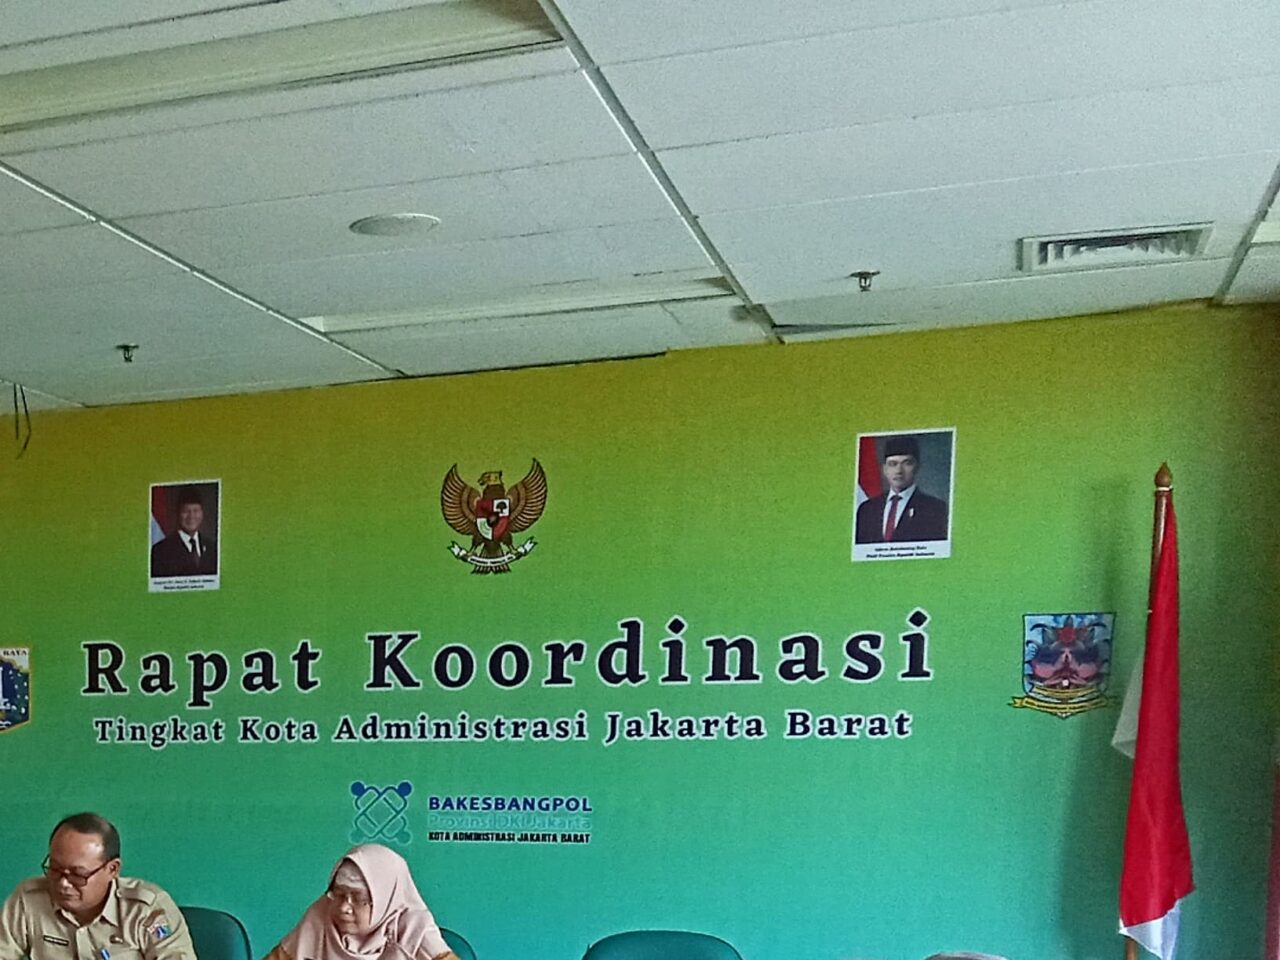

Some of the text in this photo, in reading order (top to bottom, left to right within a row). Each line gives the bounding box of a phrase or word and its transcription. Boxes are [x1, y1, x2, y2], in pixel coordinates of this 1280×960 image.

[82, 609, 931, 708] Rapat Koordinasi
[95, 710, 912, 748] Tingkat Kota Administrasi Jakarta Barat
[428, 797, 593, 811] BAKESBANGPOL
[428, 832, 591, 843] KOTA ADMINISTRASI JAKARTA BARAT
